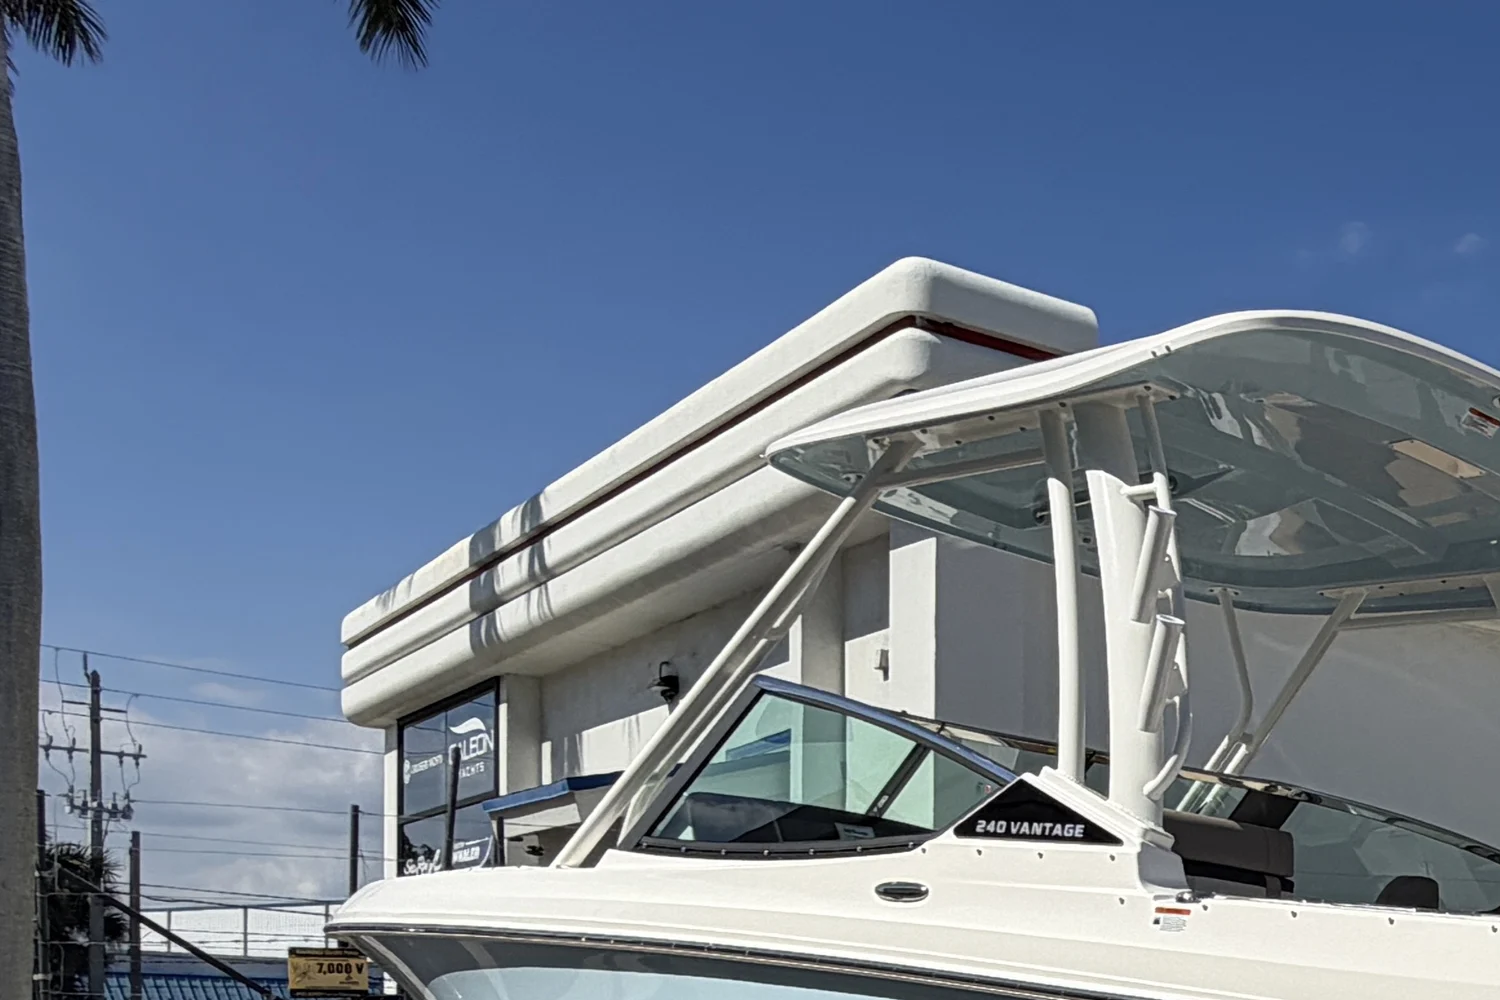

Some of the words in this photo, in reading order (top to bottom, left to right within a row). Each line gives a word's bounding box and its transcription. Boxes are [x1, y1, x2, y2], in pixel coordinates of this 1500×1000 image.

[459, 761, 485, 778] ACHTS
[975, 820, 1007, 833] 240
[1010, 821, 1085, 837] VANTAGE
[316, 963, 352, 975] 7,000
[355, 963, 364, 974] V
